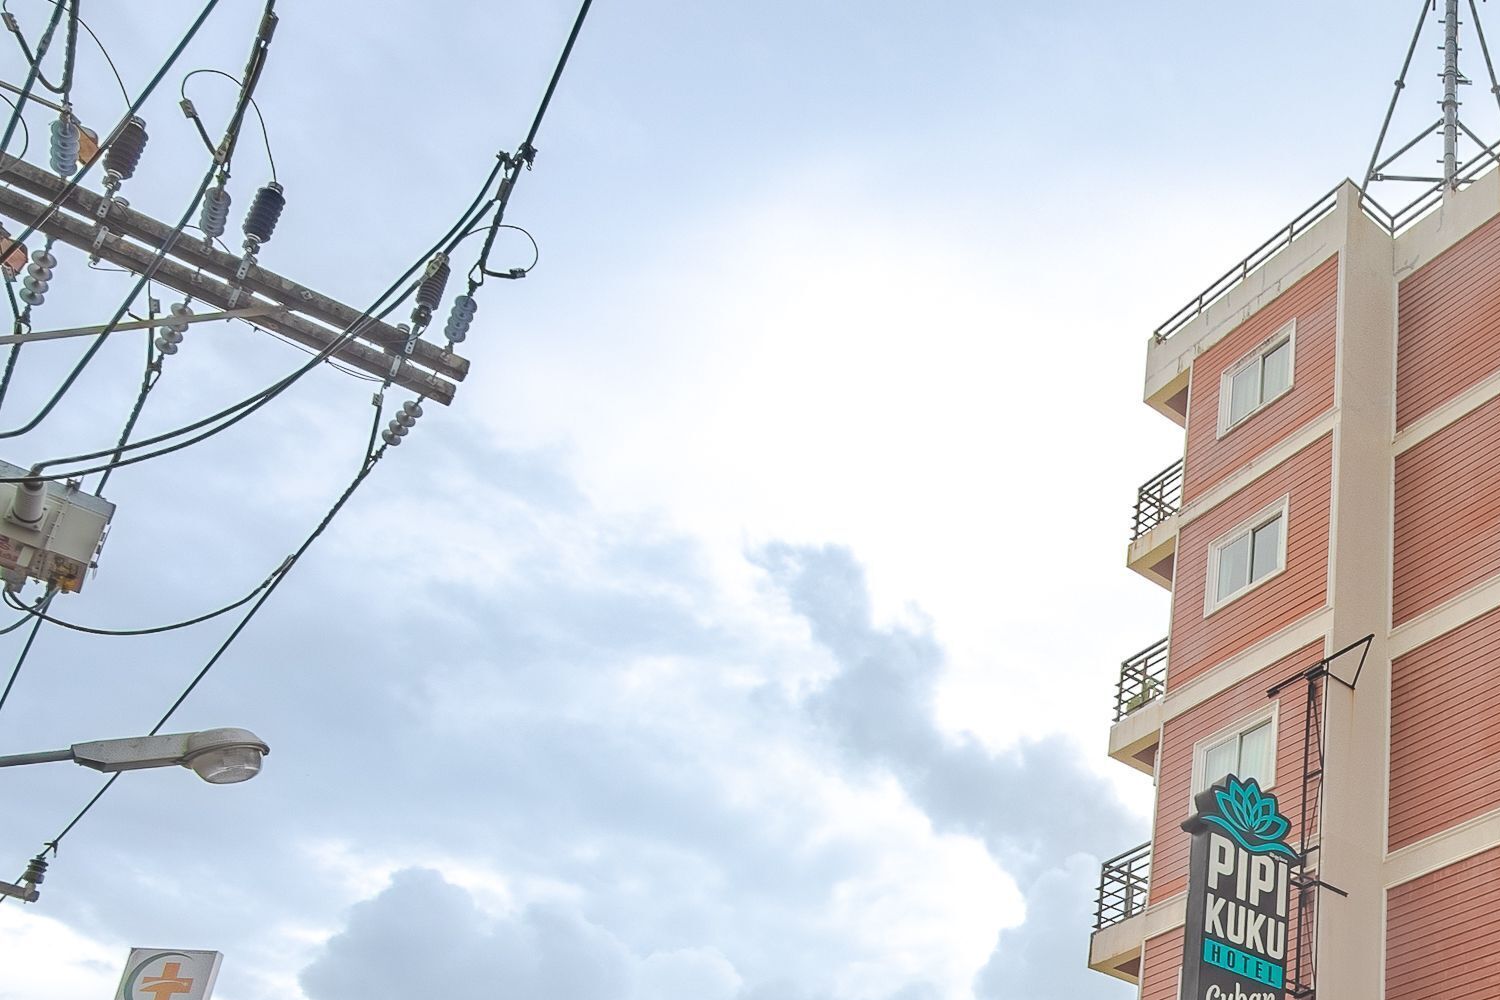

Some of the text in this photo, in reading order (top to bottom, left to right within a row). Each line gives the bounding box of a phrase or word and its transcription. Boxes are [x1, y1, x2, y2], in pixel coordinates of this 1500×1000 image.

[1207, 832, 1288, 917] PIPI
[1204, 892, 1285, 960] KUKU
[1211, 943, 1277, 984] HOTEL
